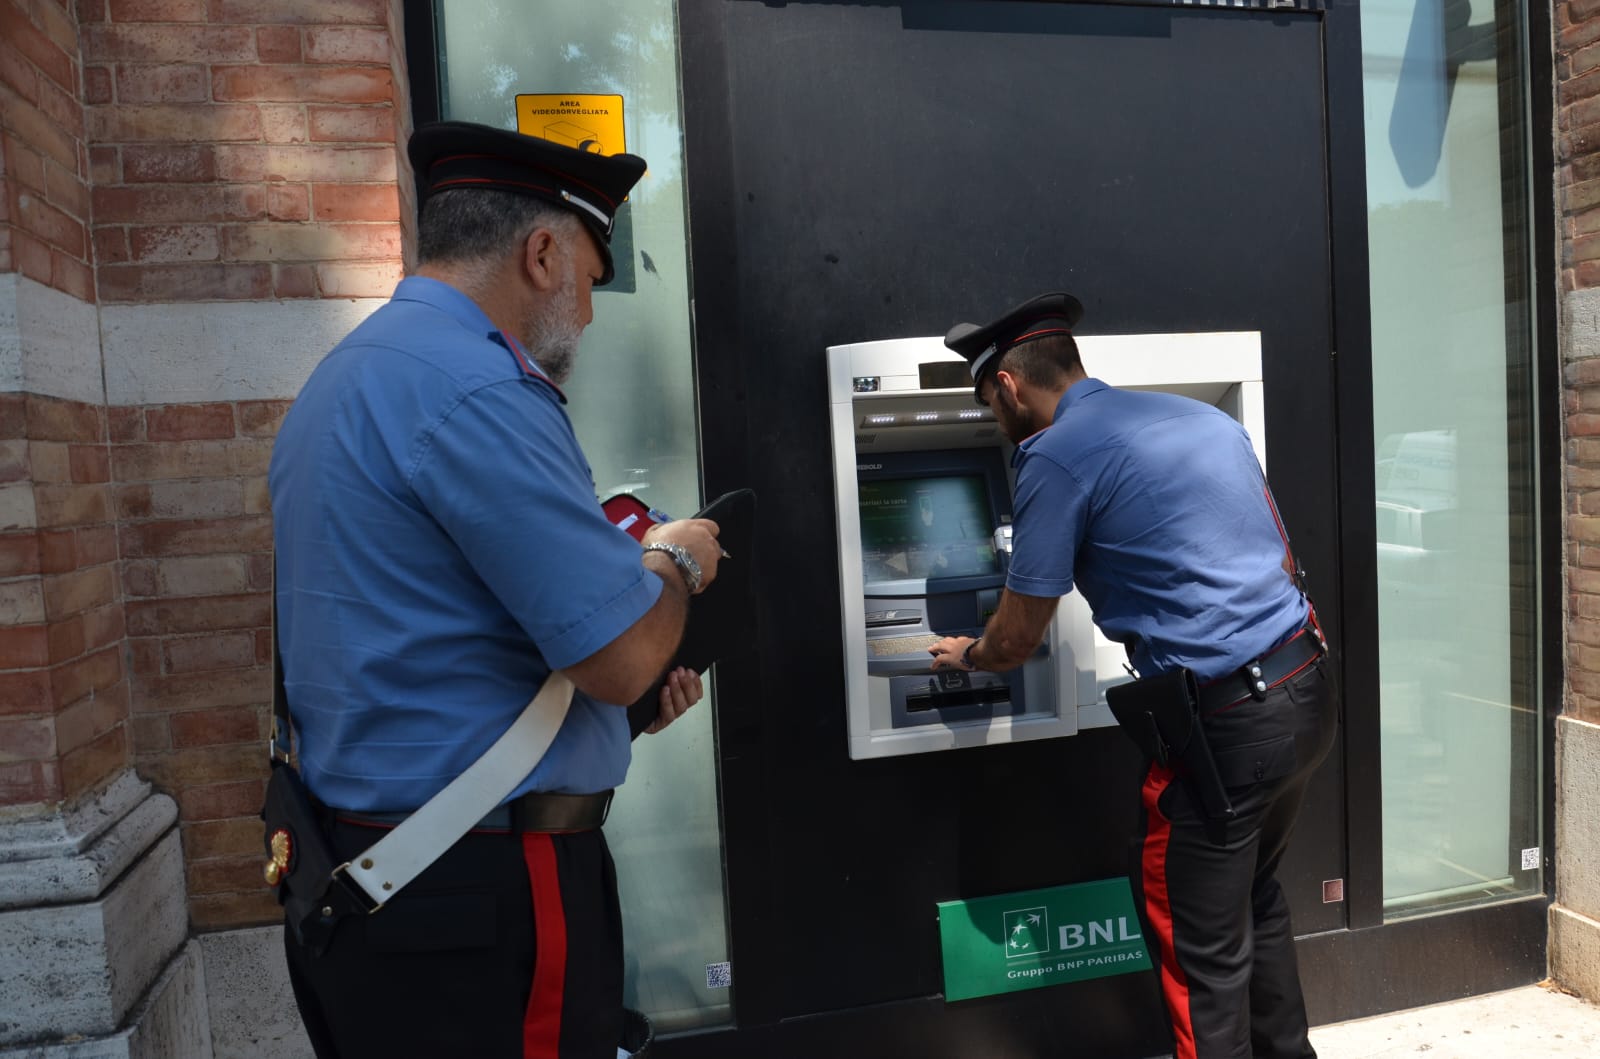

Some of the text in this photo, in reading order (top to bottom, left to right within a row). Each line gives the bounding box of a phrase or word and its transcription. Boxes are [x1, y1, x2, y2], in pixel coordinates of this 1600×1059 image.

[1058, 916, 1141, 950] BNL
[1007, 950, 1144, 980] Gruppo BNP PARIBAS
